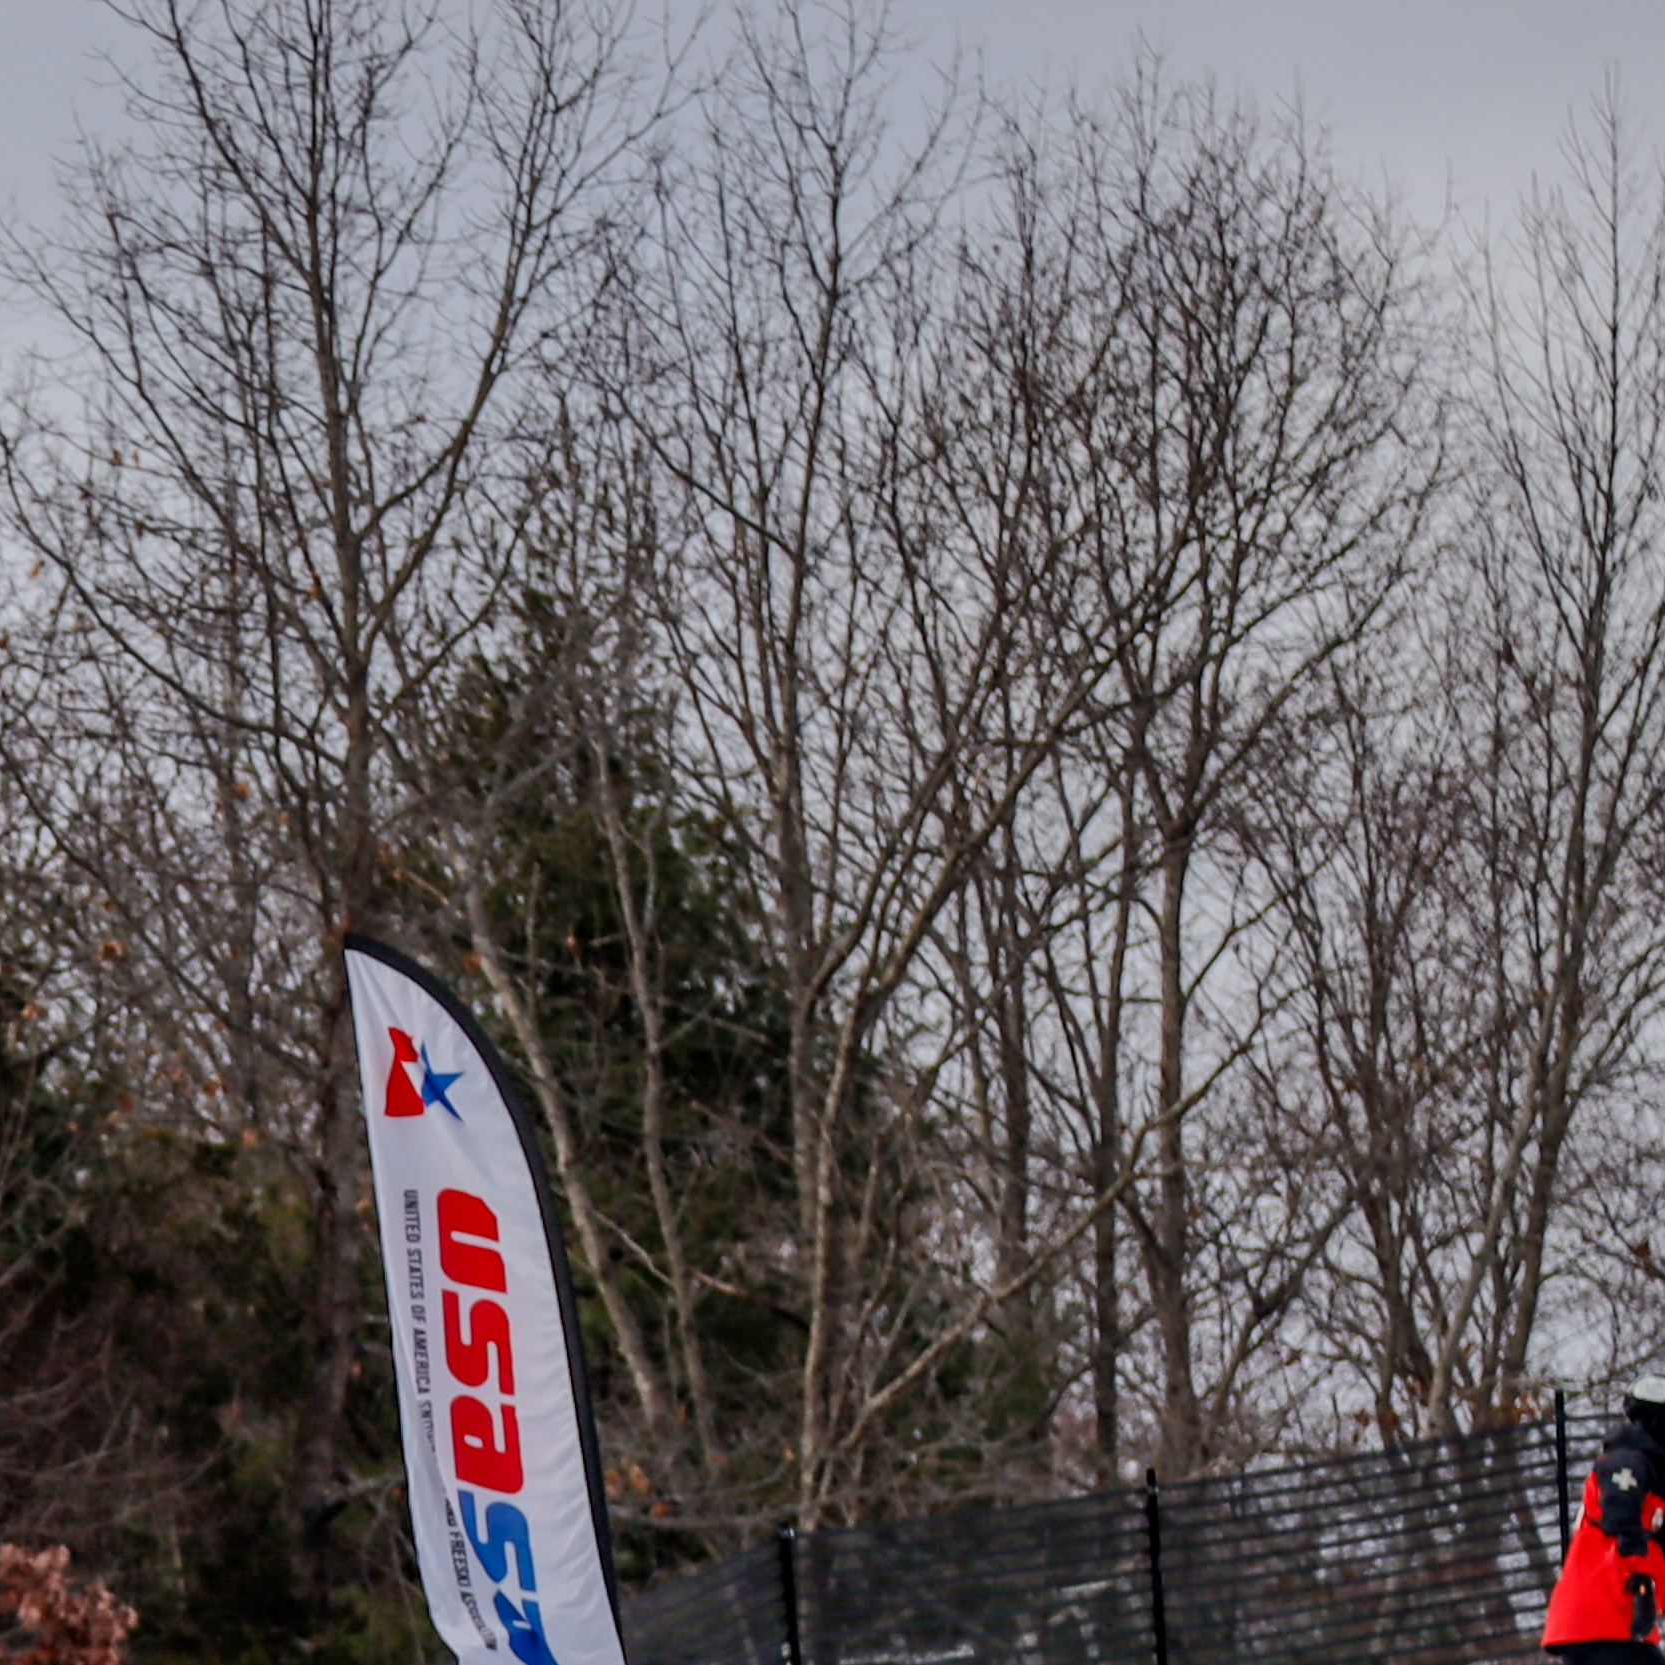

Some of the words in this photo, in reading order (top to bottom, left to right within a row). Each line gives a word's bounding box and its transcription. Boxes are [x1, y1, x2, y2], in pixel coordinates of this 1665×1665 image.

[403, 1189, 421, 1244] UNITED
[407, 1248, 424, 1299] STATES
[411, 1304, 427, 1323] OF
[413, 1328, 431, 1394] AMERICA
